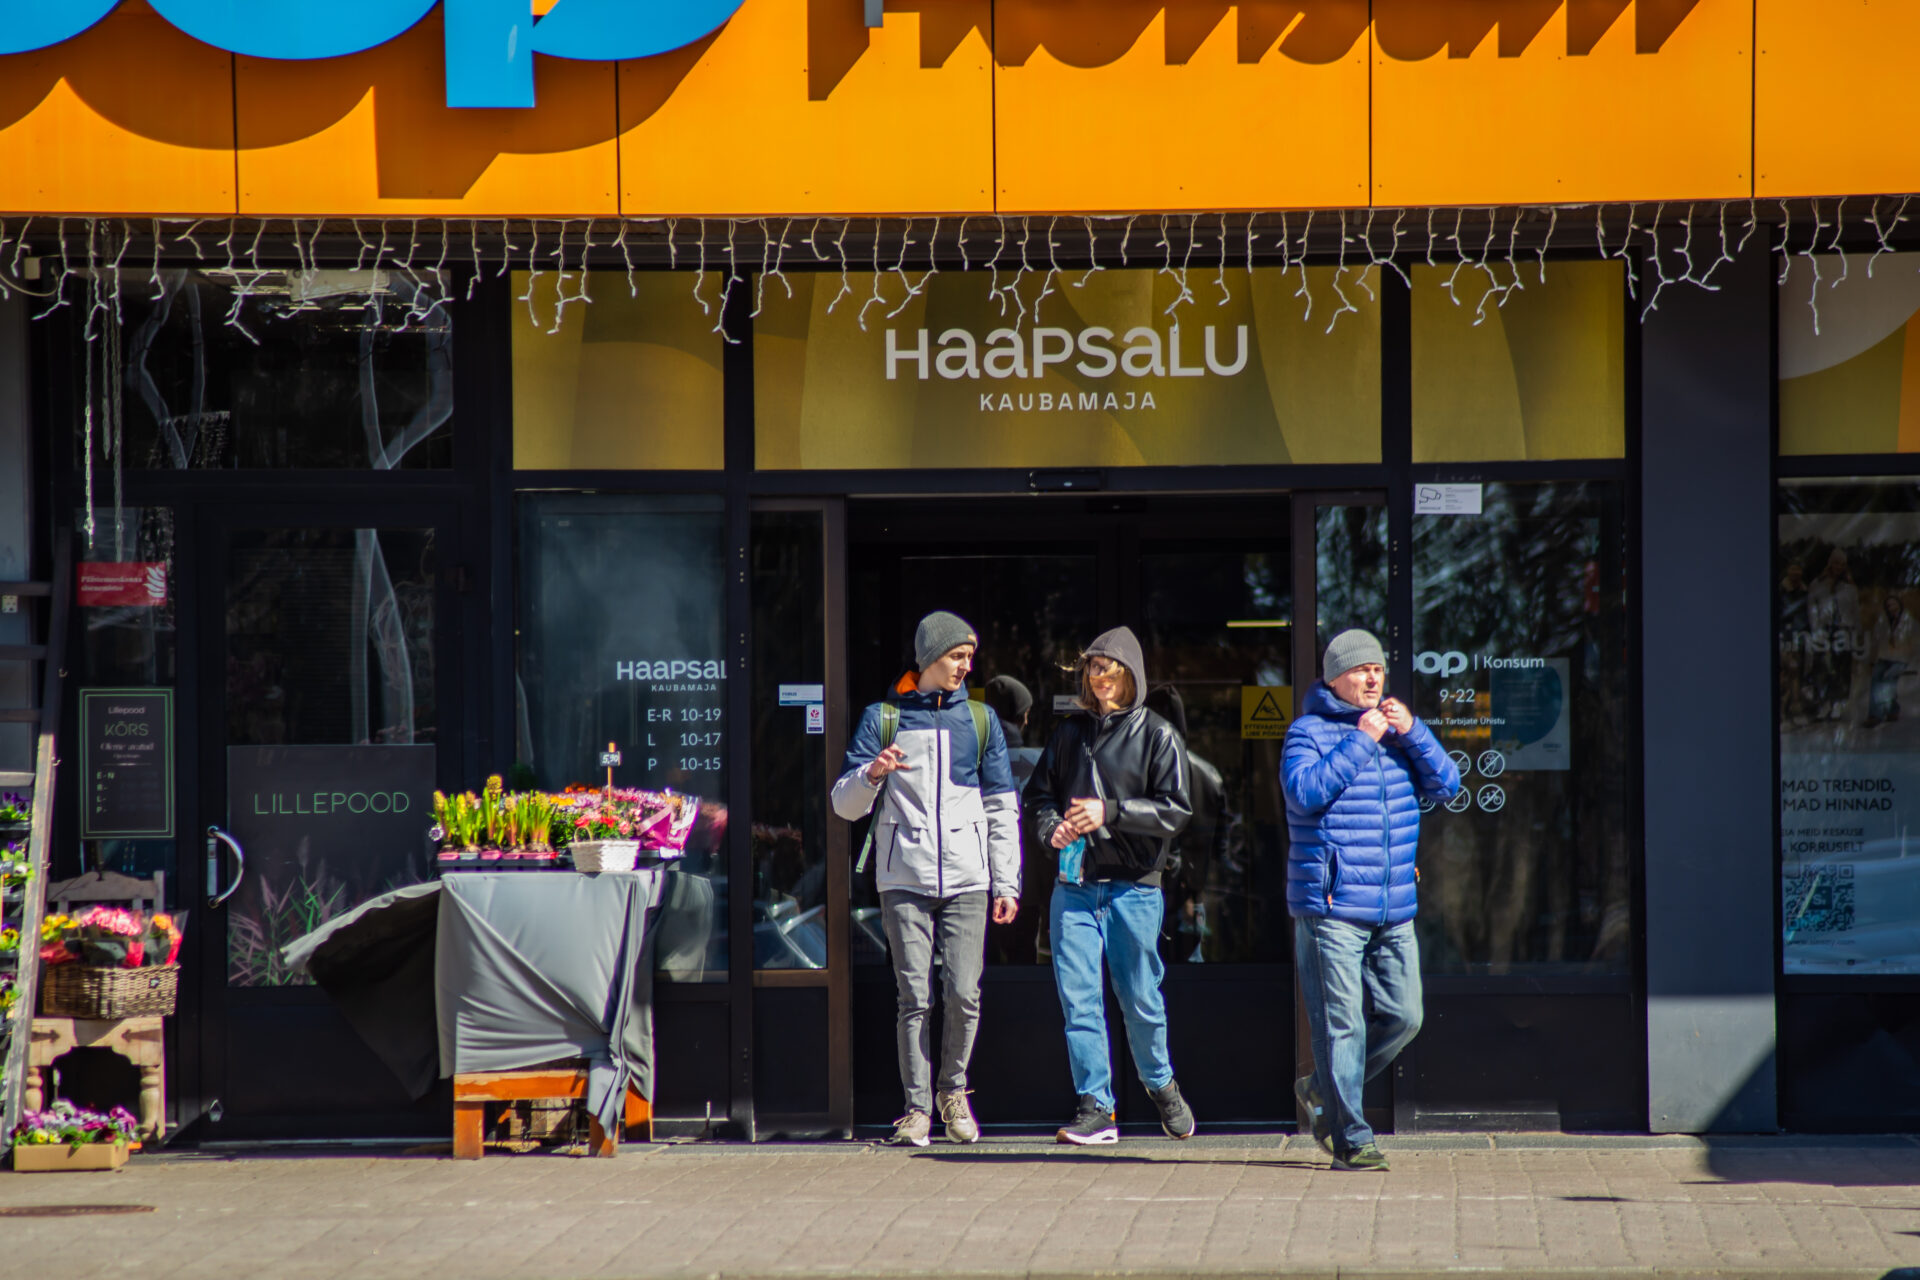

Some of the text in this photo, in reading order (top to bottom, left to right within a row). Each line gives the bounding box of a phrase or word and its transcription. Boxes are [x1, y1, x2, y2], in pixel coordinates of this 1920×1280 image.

[980, 392, 1156, 411] KAUBAMAJA
[1779, 623, 1872, 662] insay
[1412, 650, 1545, 678] op Konsum
[651, 684, 717, 692] KAUBAMAJA
[1439, 688, 1476, 703] 9-22
[107, 706, 146, 716] Lillepood
[647, 708, 722, 722] E-R 10-19
[1444, 717, 1478, 727] Tarbijate
[1480, 715, 1506, 726] Ühistu
[647, 733, 722, 747] L 10-17
[647, 757, 722, 771] P 10-15
[1822, 779, 1896, 794] TRENDID,
[254, 792, 410, 815] LILLEPOOD
[1825, 797, 1892, 811] HINNAD
[1797, 828, 1821, 837] MEID
[1823, 828, 1864, 837] KESKUSE
[1790, 841, 1865, 853] KORRUSELT
